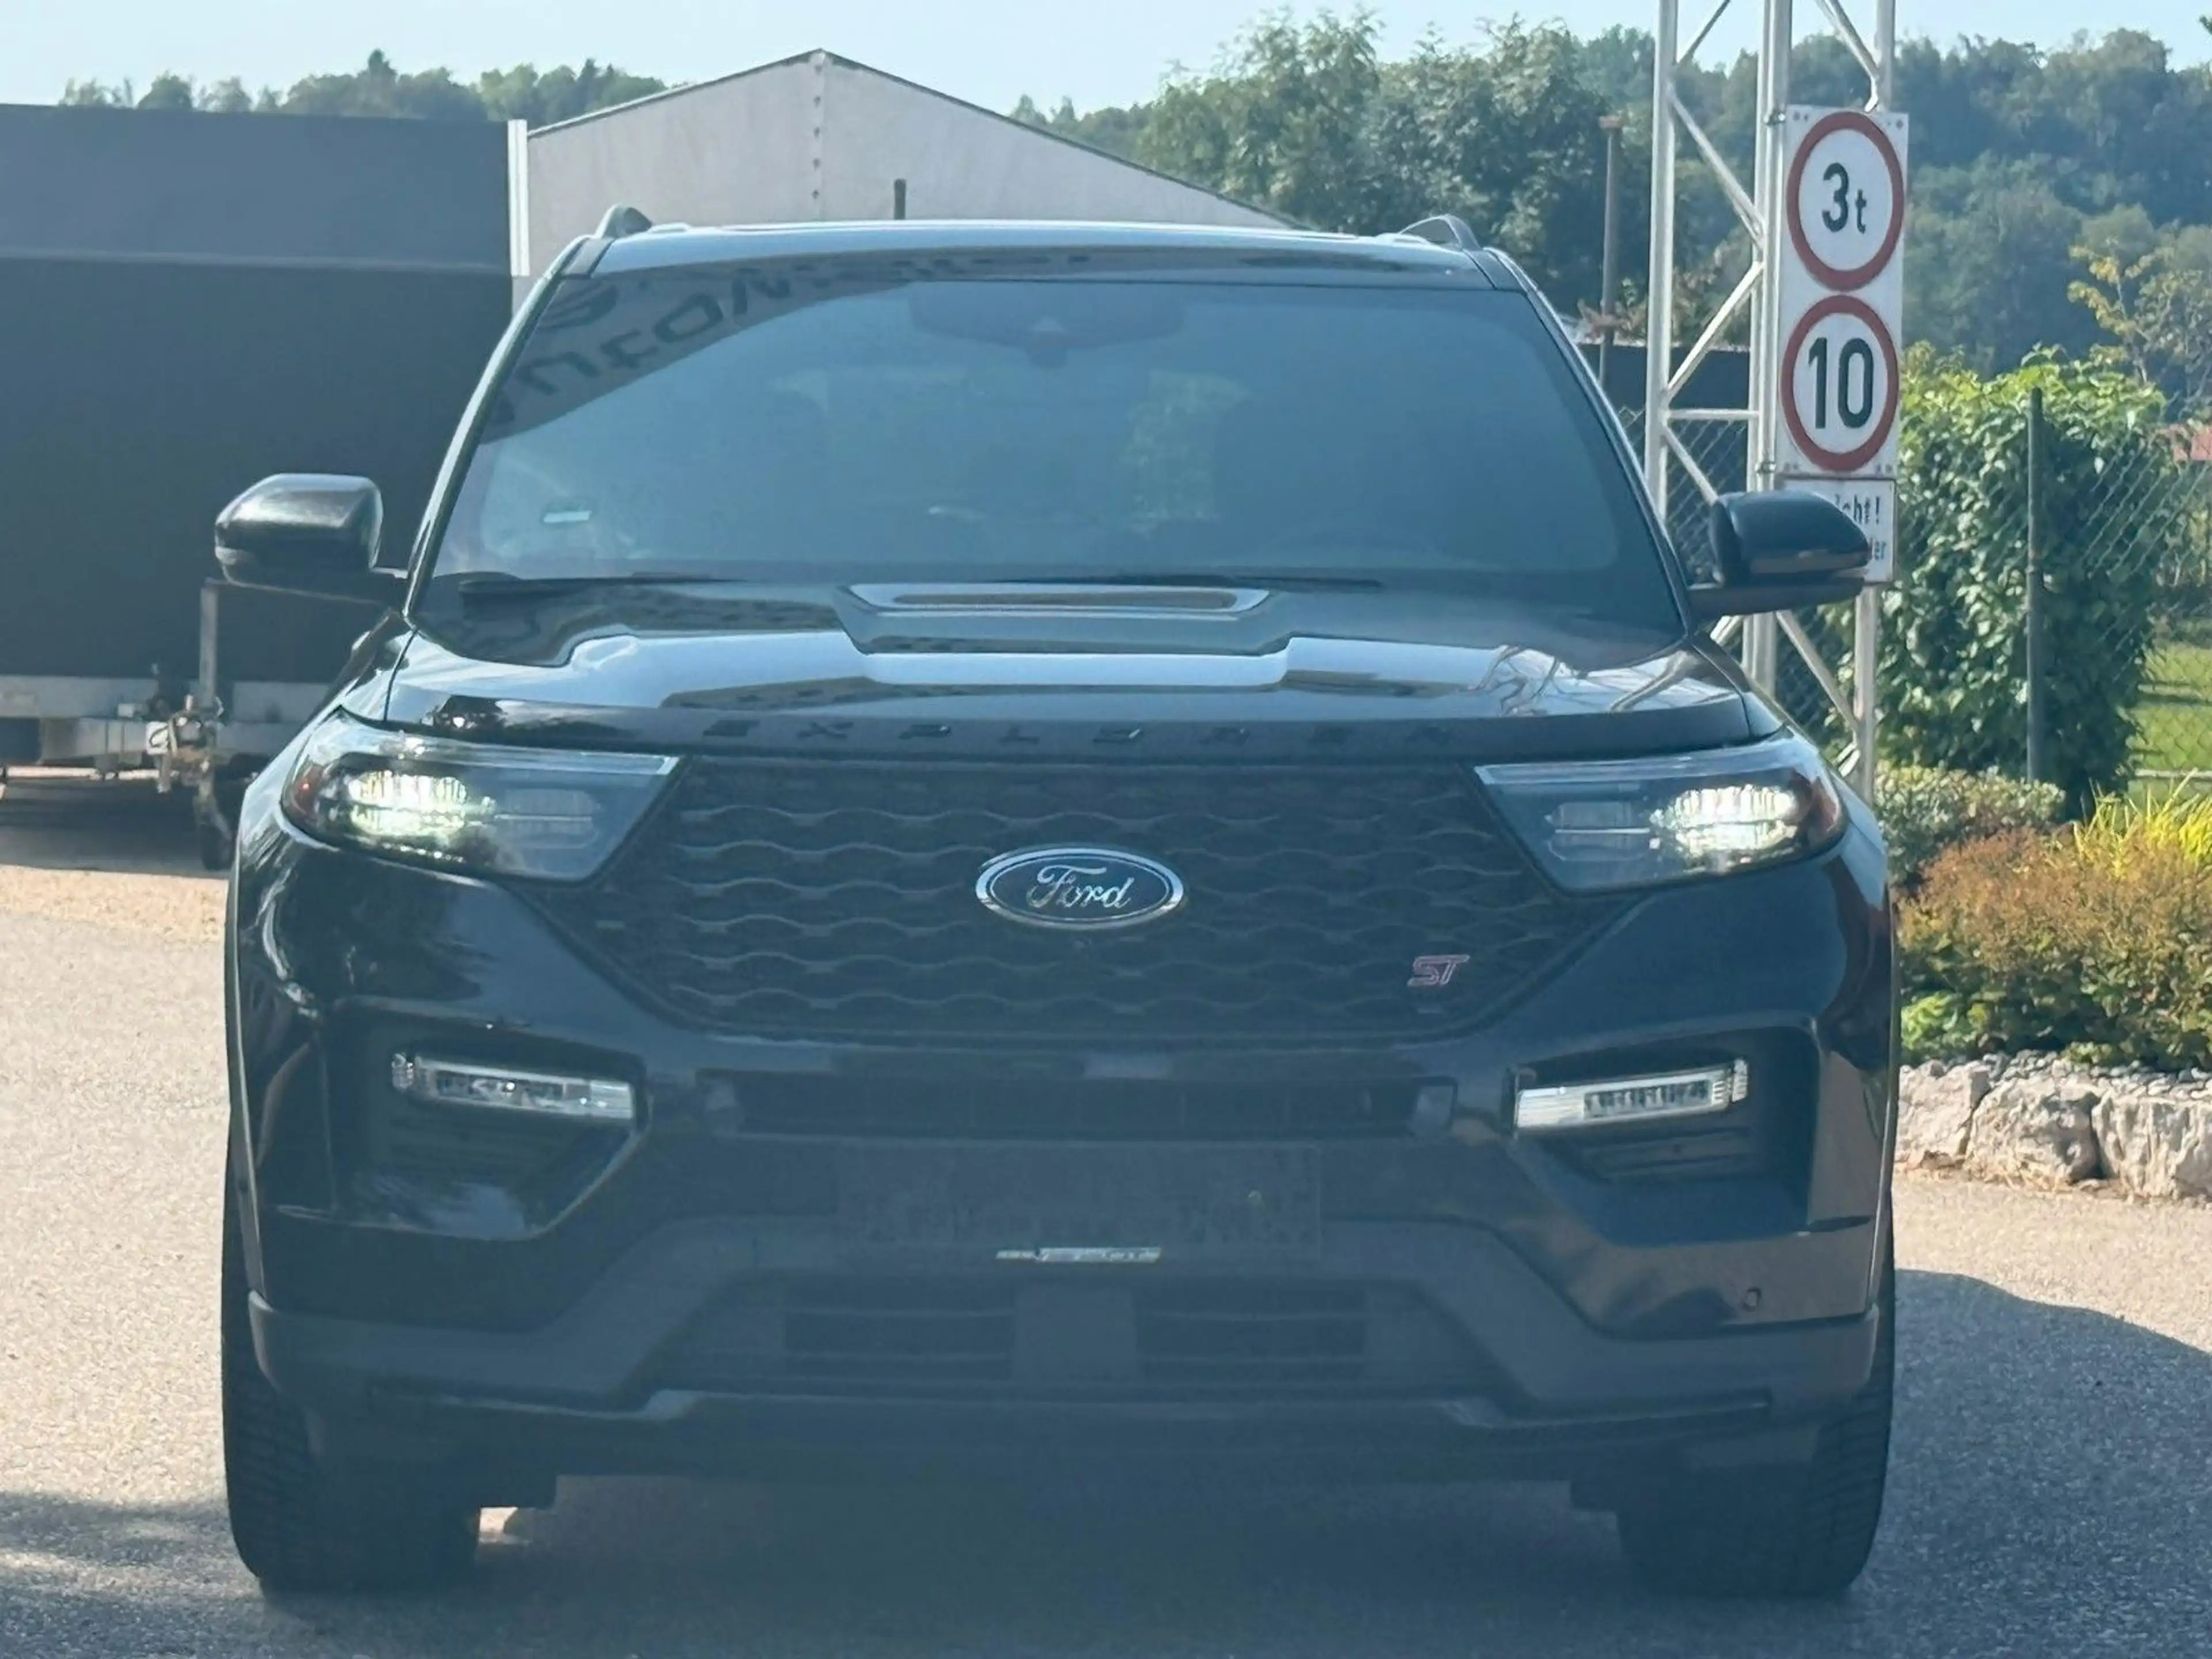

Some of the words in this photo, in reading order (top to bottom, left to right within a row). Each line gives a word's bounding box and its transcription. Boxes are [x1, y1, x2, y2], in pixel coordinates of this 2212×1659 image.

[1808, 337, 1874, 429] 10
[1027, 865, 1134, 908] Ford
[1407, 954, 1471, 987] ST
